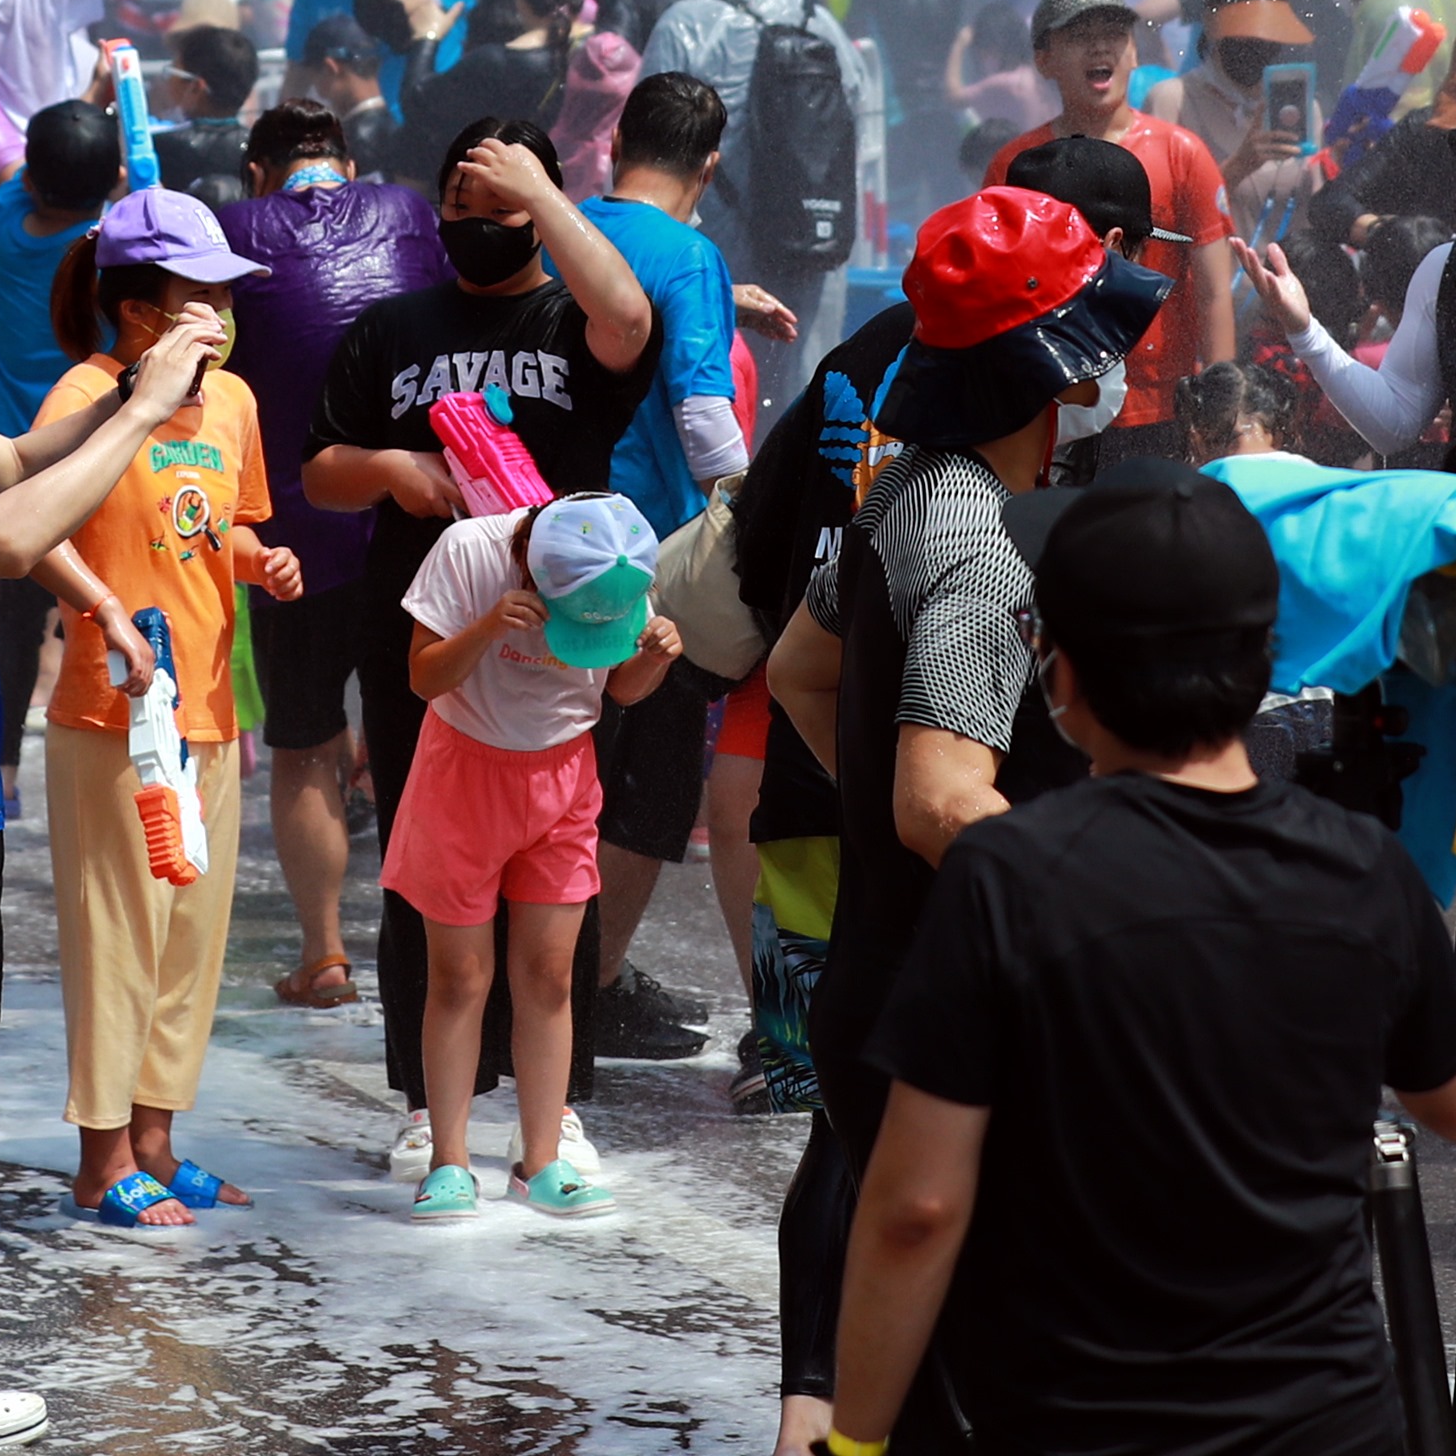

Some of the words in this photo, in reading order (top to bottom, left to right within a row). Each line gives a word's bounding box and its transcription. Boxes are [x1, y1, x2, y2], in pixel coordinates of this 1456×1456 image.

[391, 349, 573, 420] SAVAGE
[149, 439, 225, 474] GARDEN
[498, 643, 569, 671] Dancing
